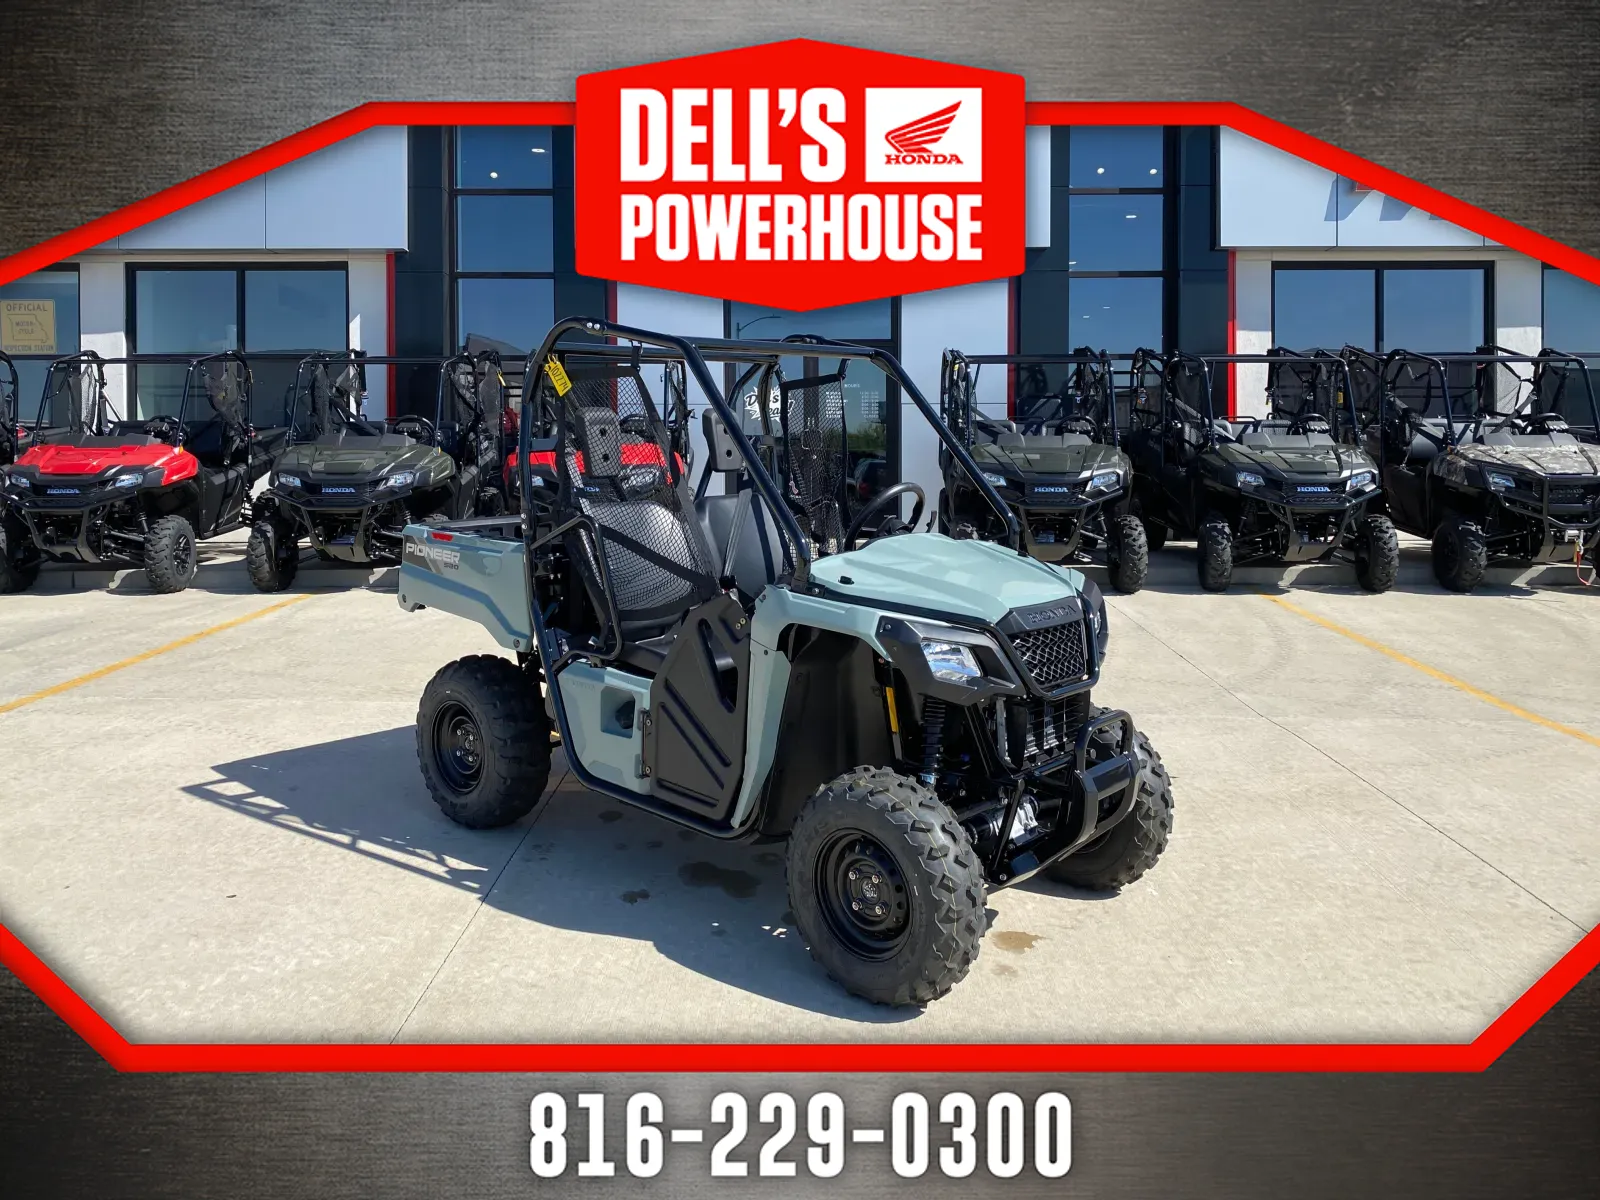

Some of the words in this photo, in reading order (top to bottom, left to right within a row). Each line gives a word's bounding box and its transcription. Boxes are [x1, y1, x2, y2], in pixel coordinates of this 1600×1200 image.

[6, 303, 48, 311] OFFICIAL
[405, 542, 461, 564] PIONEER
[1027, 605, 1076, 623] HONDA
